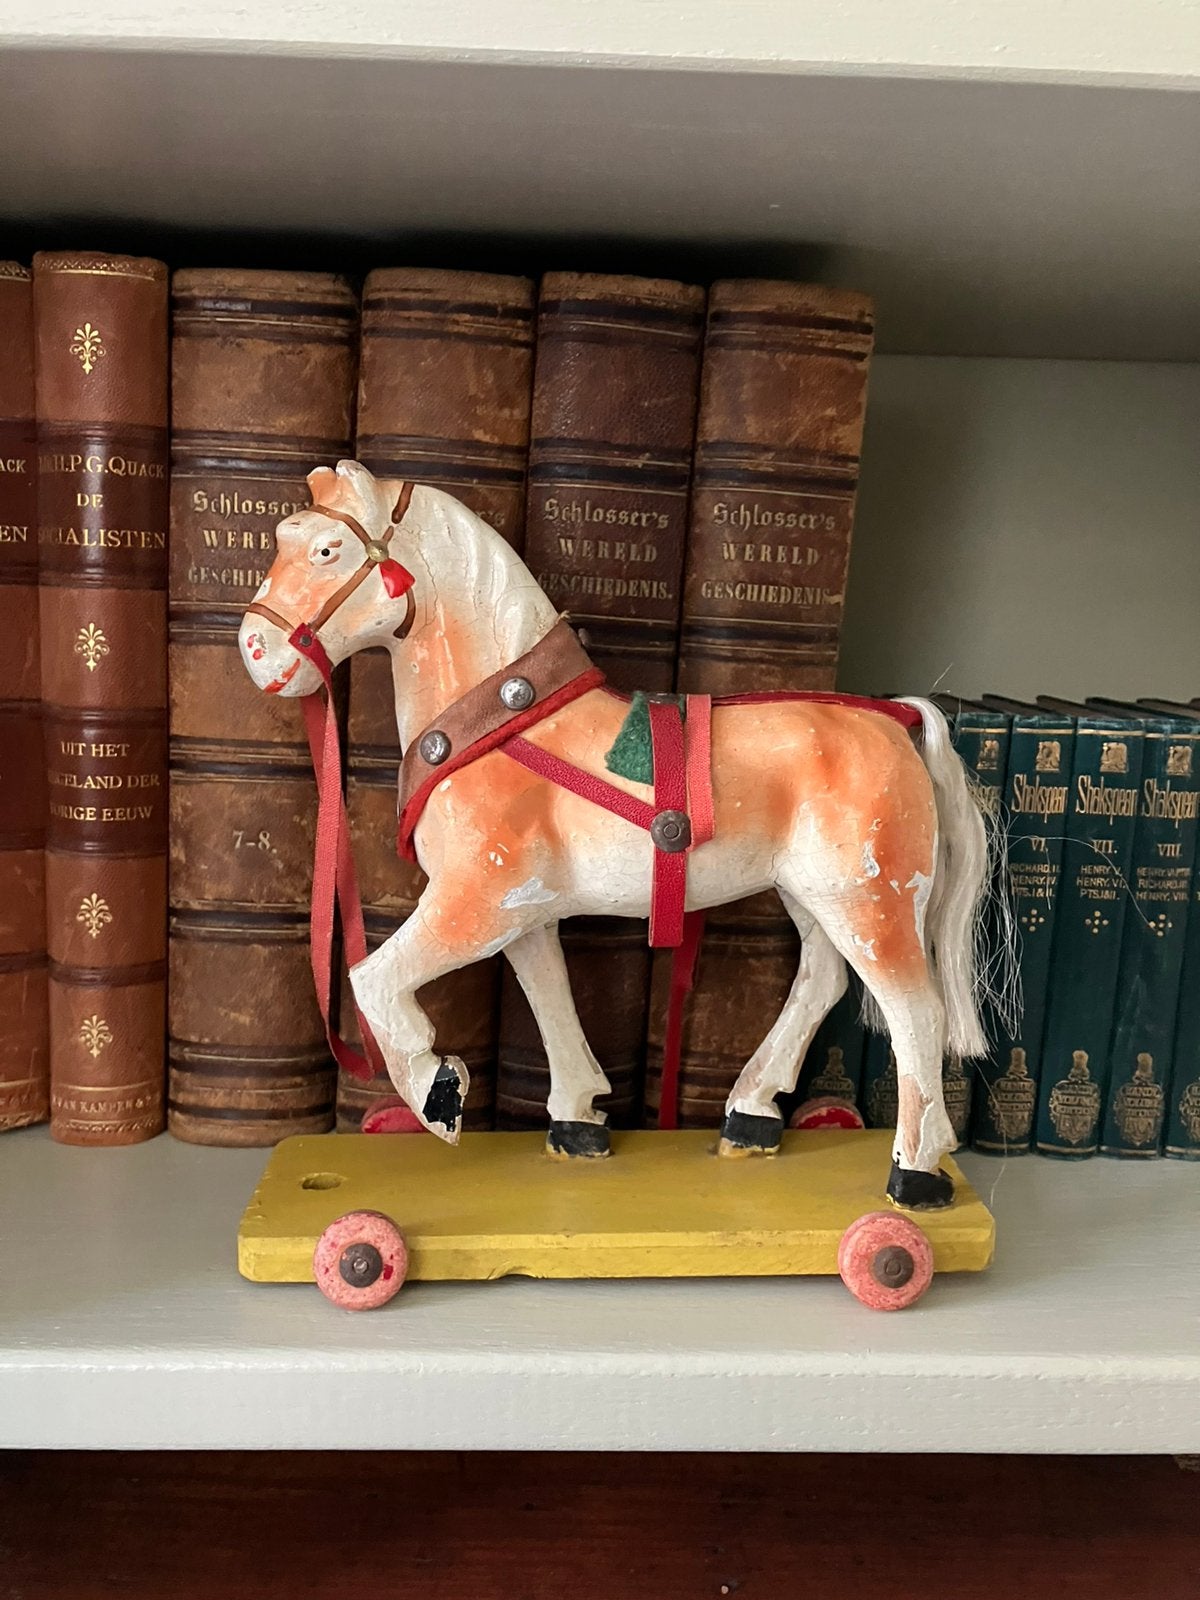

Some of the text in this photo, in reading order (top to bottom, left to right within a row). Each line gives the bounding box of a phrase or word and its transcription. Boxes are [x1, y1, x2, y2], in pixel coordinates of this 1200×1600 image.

[76, 493, 104, 509] DE
[193, 490, 310, 519] Schlosser'
[544, 498, 669, 529] Schlosser's
[713, 503, 836, 531] Schlosser's
[203, 529, 270, 550] WERE
[558, 538, 657, 563] WERELD
[722, 543, 819, 566] WERELD
[61, 741, 130, 758] UIT HET
[127, 773, 160, 788] DER
[102, 805, 153, 822] EEUW
